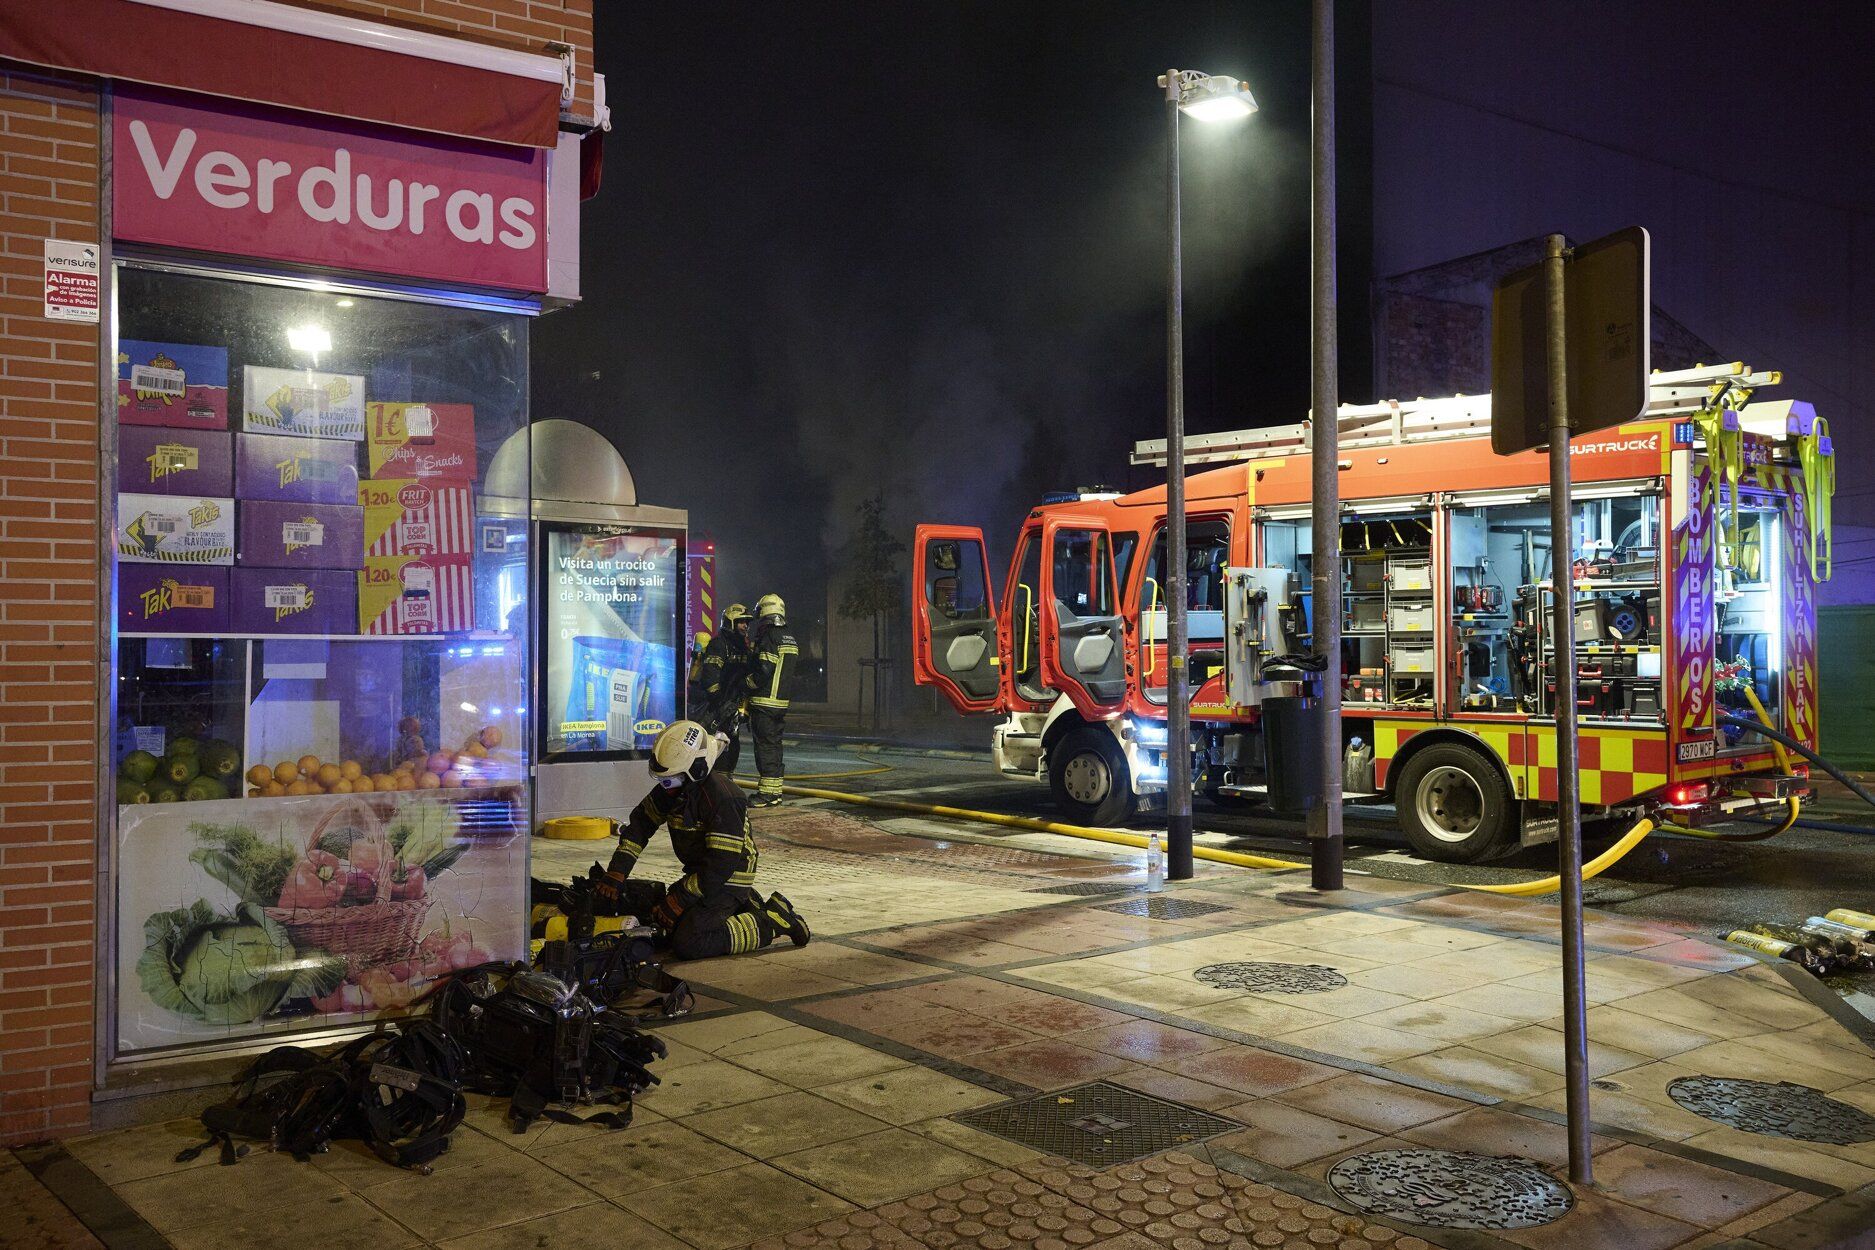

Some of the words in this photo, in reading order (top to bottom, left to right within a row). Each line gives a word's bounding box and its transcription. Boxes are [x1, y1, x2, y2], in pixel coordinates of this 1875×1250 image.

[129, 119, 537, 250] Verduras
[48, 256, 97, 269] verisure
[48, 273, 97, 287] Alarma
[68, 290, 97, 298] imágenes
[370, 404, 401, 437] 1€
[1570, 439, 1648, 455] SURTRUCK
[382, 446, 416, 463] Chips
[422, 453, 463, 470] Snacks
[402, 490, 426, 500] FRIT
[406, 525, 426, 534] TOP
[559, 557, 594, 569] Visita
[597, 560, 612, 570] un
[615, 559, 656, 571] trocito
[559, 573, 574, 585] de
[576, 574, 617, 586] Suecia
[619, 575, 639, 587] sin
[639, 575, 665, 587] salir
[560, 590, 574, 601] de
[1688, 479, 1703, 714] BOMBEROS
[407, 603, 427, 612] TOP
[1794, 492, 1805, 724] SUHILTZAILEAK
[588, 662, 609, 678] IKE
[636, 723, 663, 731] IKEA
[1681, 744, 1699, 759] 2970
